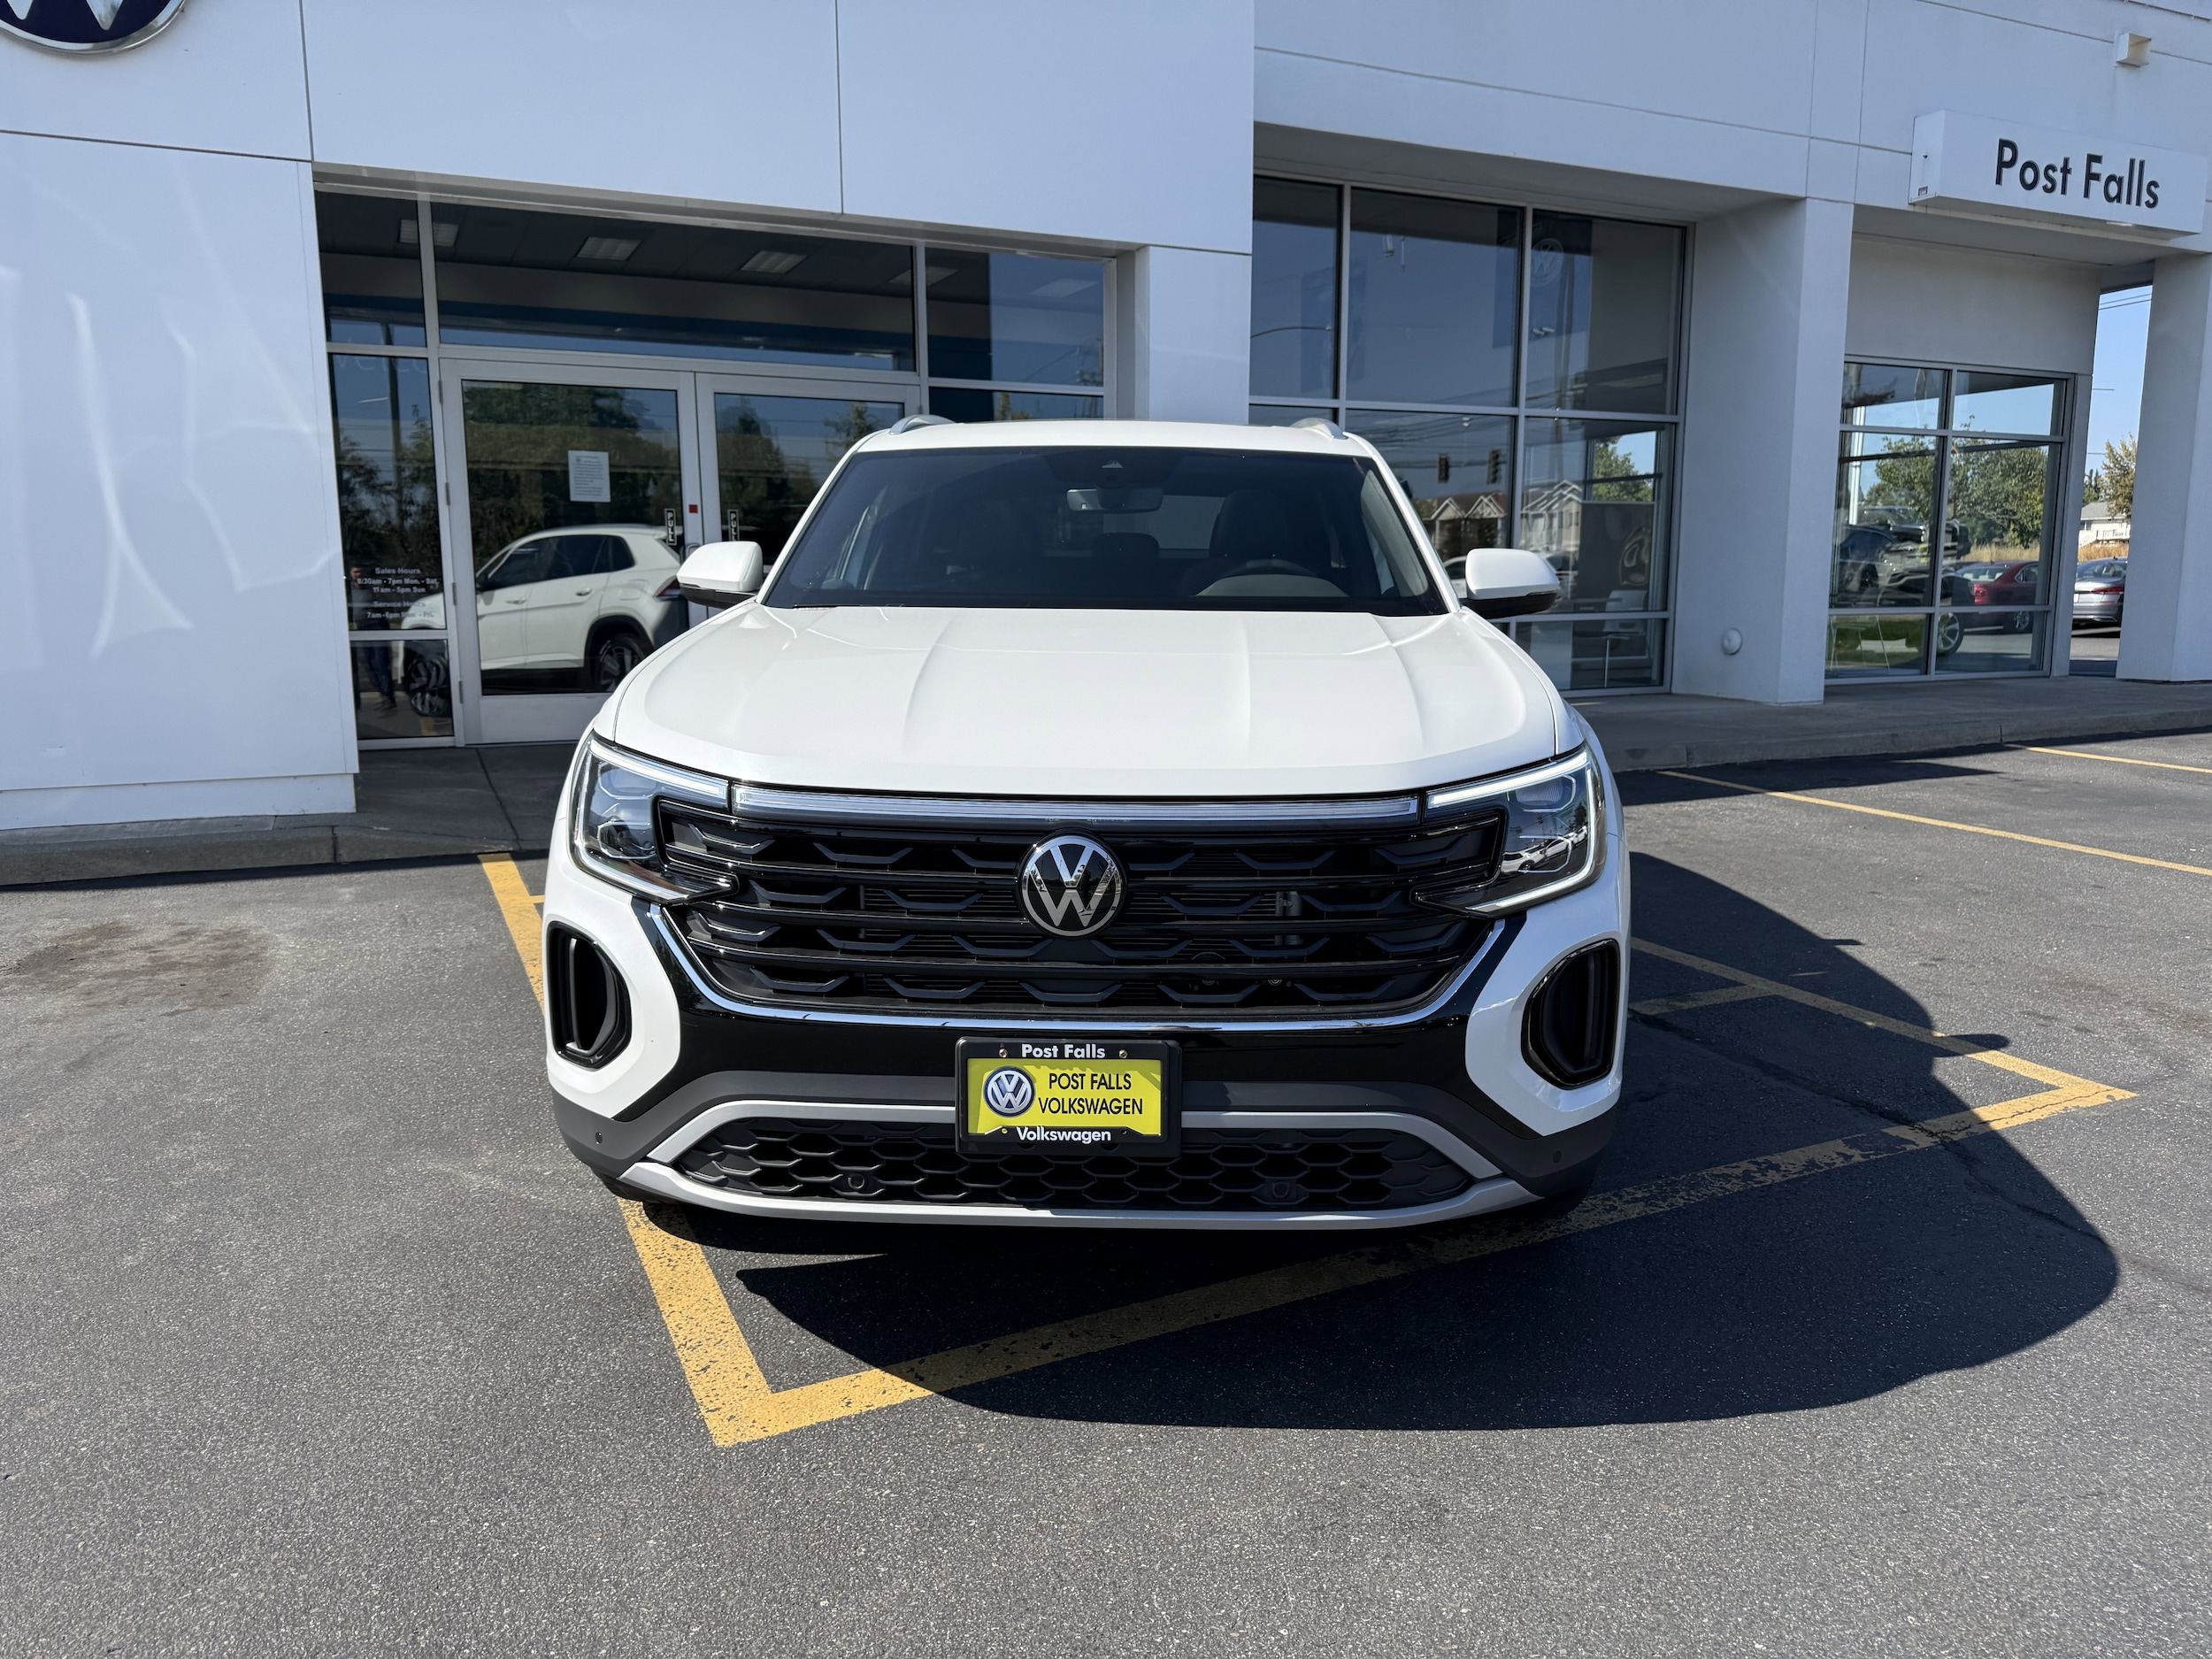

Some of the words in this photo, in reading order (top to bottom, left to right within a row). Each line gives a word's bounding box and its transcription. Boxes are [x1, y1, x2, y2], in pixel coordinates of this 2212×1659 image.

[1995, 137, 2072, 196] Post
[2083, 153, 2161, 209] Falls
[1021, 1043, 1059, 1058] Post
[1064, 1043, 1106, 1059] Falls
[1048, 1072, 1087, 1090] POST
[1090, 1073, 1132, 1091] FALLS
[1038, 1097, 1143, 1115] VOLKSWAGEN
[1017, 1126, 1111, 1144] Volkswagen
